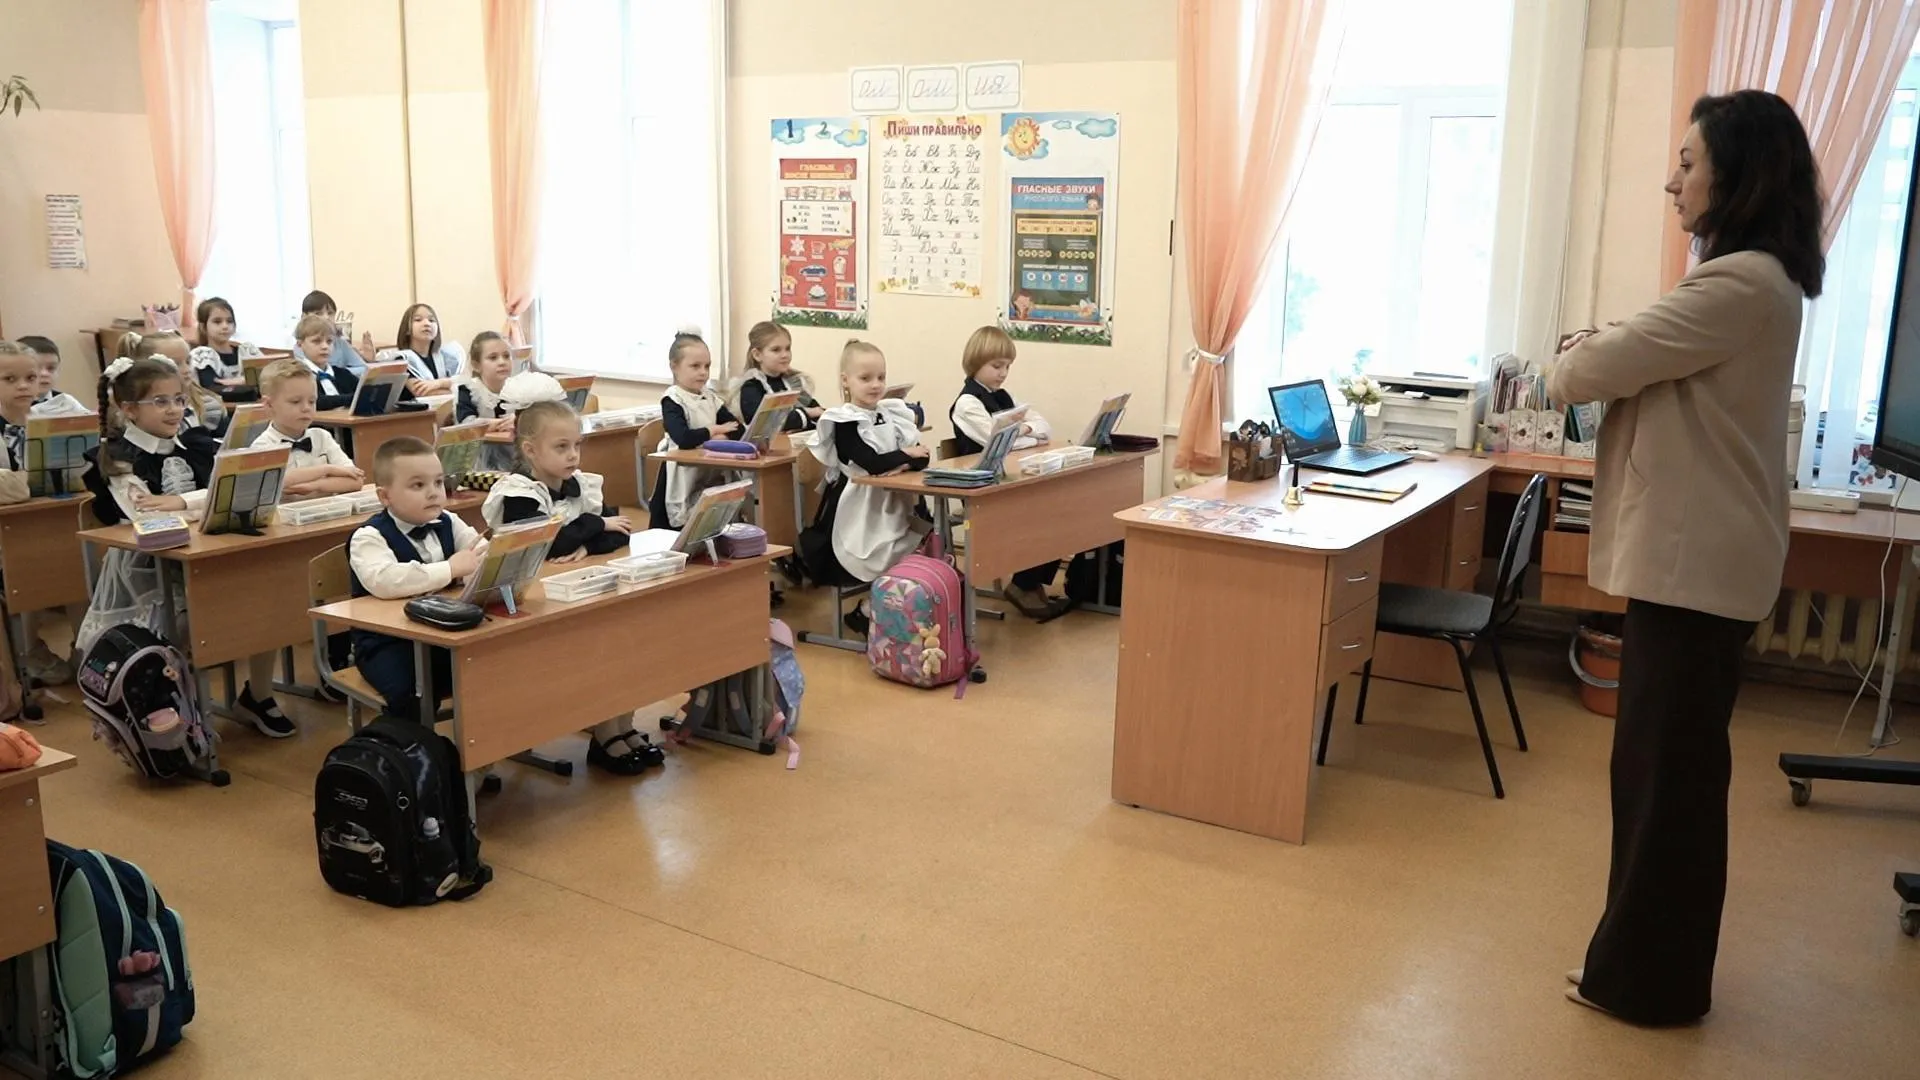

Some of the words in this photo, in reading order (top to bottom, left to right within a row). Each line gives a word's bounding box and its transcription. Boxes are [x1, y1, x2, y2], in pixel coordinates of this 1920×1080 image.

[787, 119, 793, 138] 1
[821, 121, 828, 135] 2
[1018, 185, 1061, 194] ГЛАСНЫЕ
[1066, 185, 1096, 194] ЗВУКИ
